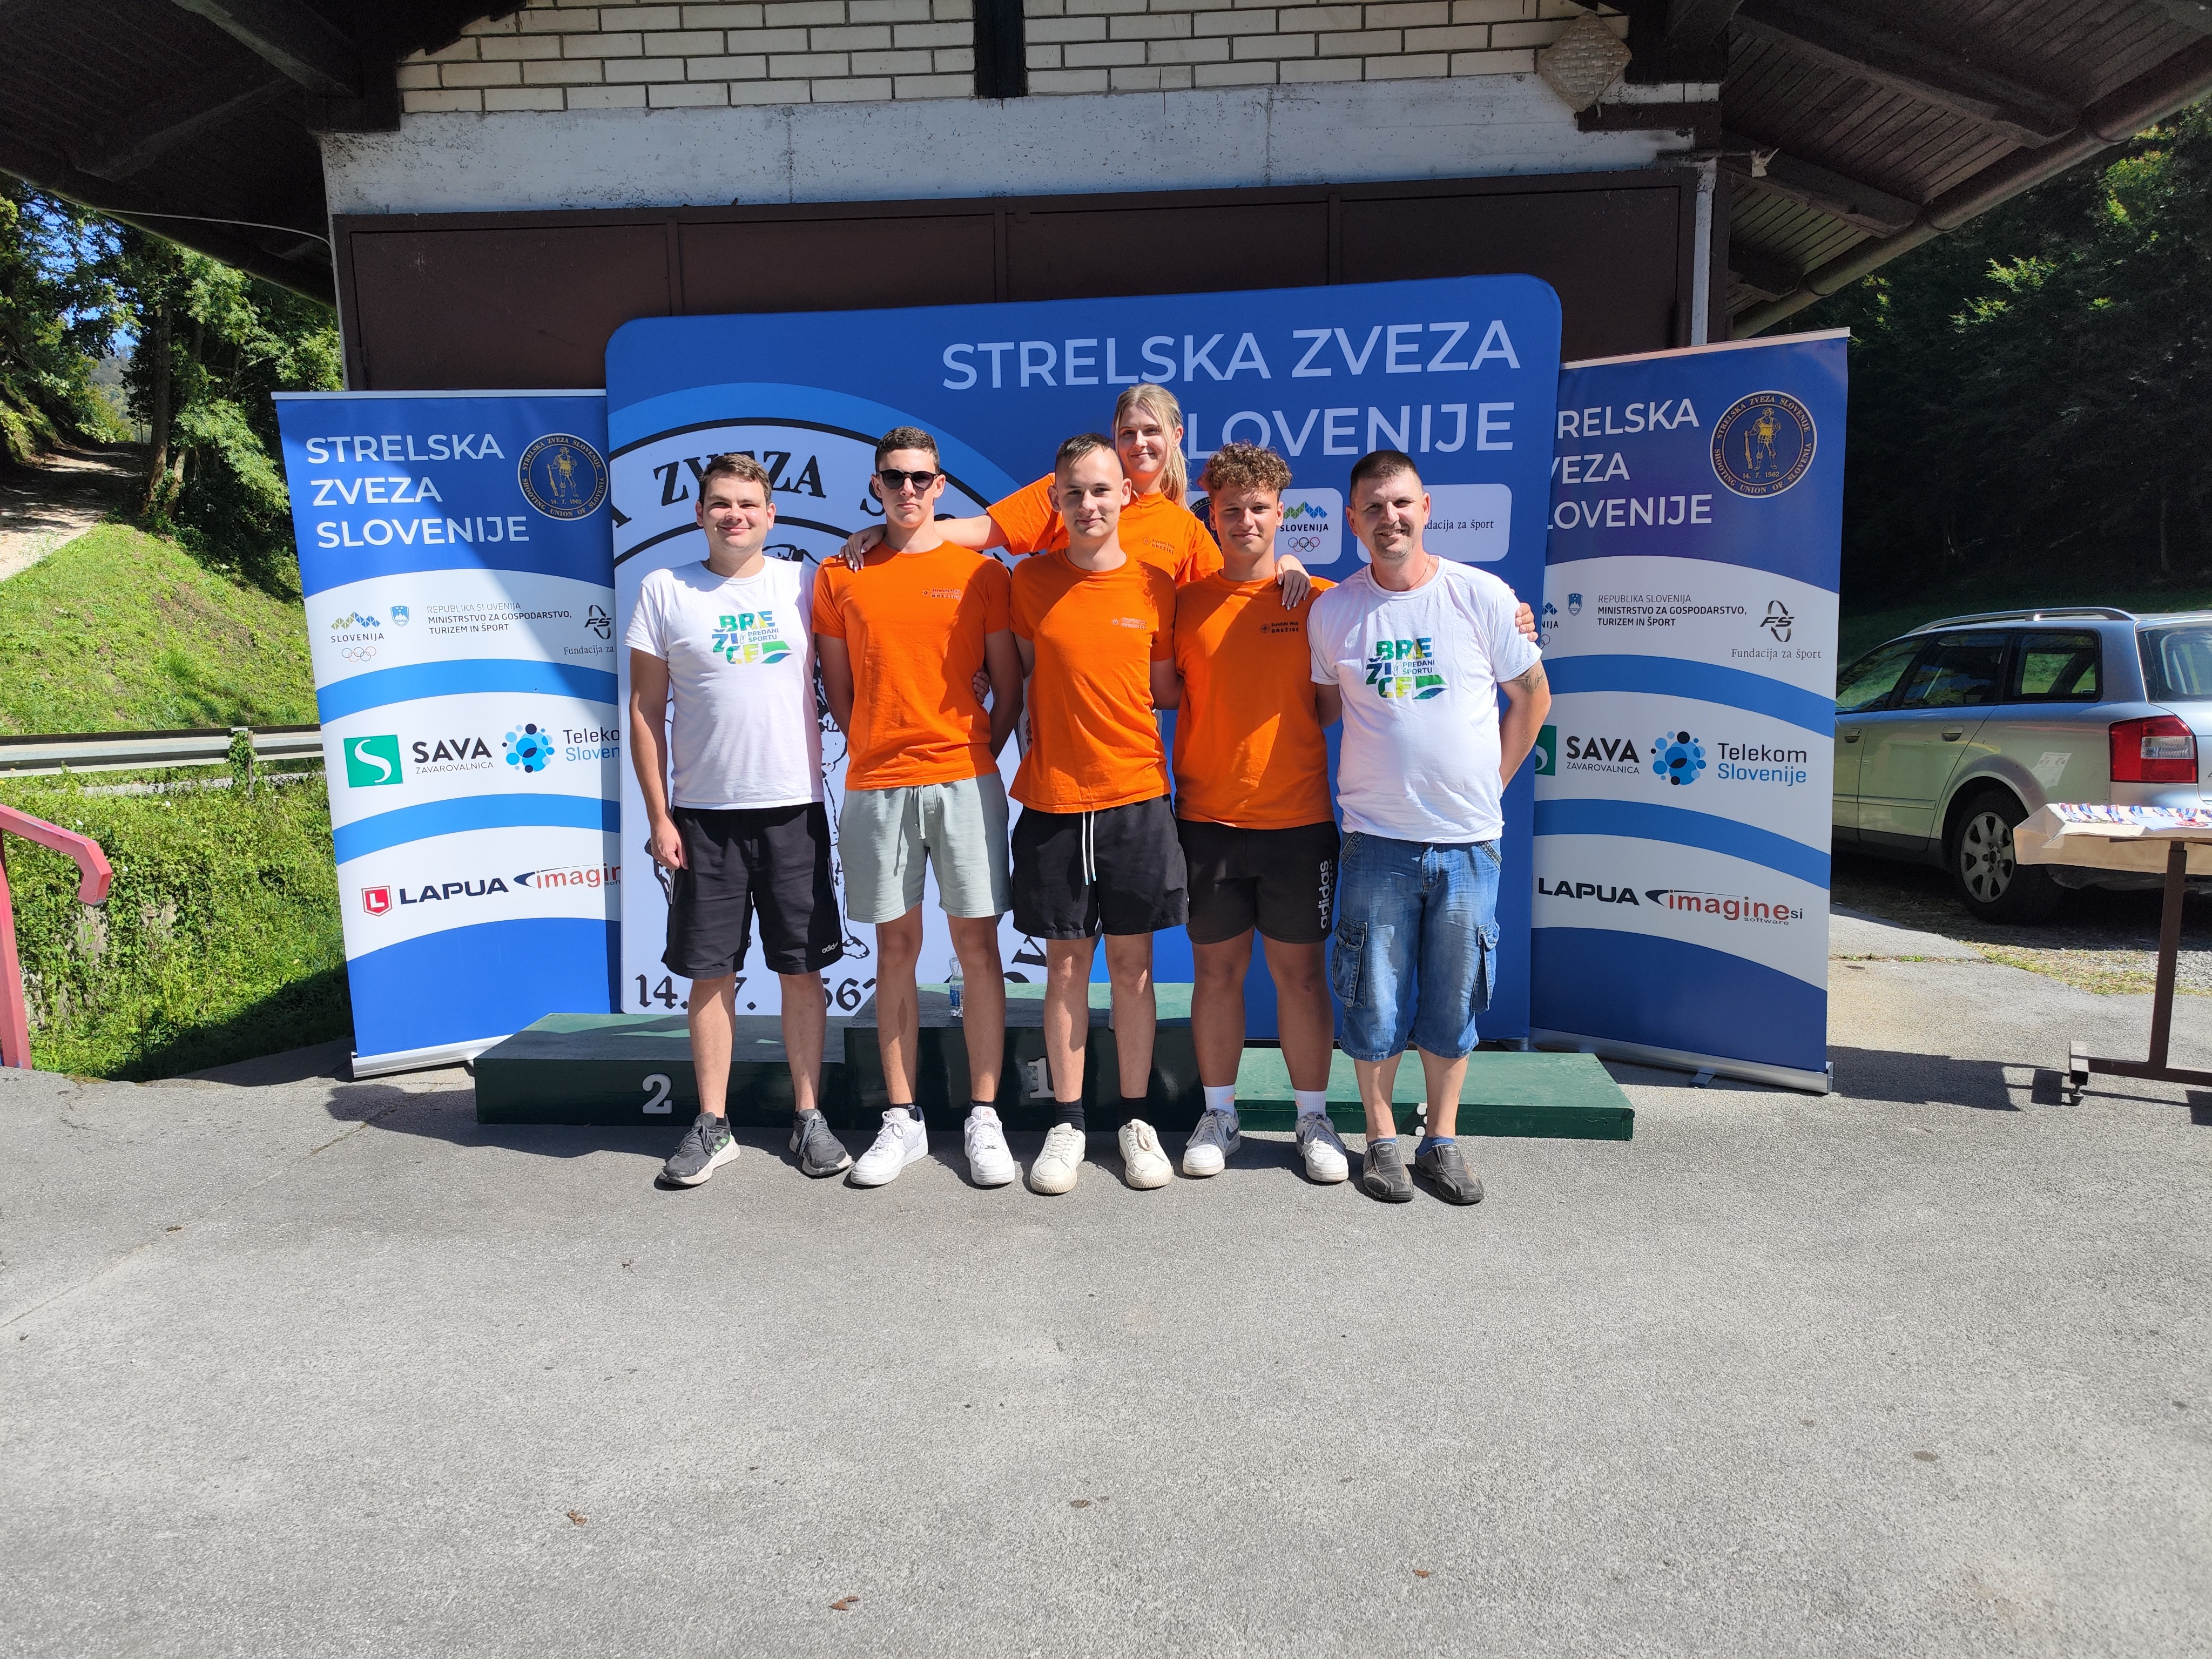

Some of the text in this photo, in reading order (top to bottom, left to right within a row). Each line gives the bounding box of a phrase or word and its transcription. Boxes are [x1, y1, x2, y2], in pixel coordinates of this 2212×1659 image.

[942, 320, 1521, 390] STRELSKA ZVEZA
[1557, 398, 1700, 439] RELSKA
[1717, 396, 1811, 439] STRELSKA ZVEZA SLOVENIJE
[306, 434, 505, 464] STRELSKA
[522, 442, 545, 471] STRELSKA
[572, 440, 602, 469] SLOVENIJE
[653, 450, 826, 506] ZVZA
[1715, 443, 1812, 494] SHOOTING UNION OF SLOVENIA
[311, 477, 443, 506] ZVEZA
[522, 477, 605, 517] SHOOTING UNION OF SLOVENIA
[1547, 494, 1712, 529] OVENIJE
[317, 516, 529, 548] SLOVENIJE
[1280, 523, 1328, 532] SLOVENIJA
[1471, 518, 1494, 530] šport
[427, 602, 521, 613] REPUBLIKA SLOVENIJA
[1598, 595, 1691, 604] REPUBLIKA SLOVENIJA
[428, 613, 487, 624] MINISTRSTVO
[502, 610, 572, 621] GOSPODARSTVO,
[1597, 606, 1654, 615] MINISTRSTVO
[1670, 606, 1747, 616] GOSPODARSTVO,
[1597, 618, 1634, 626] TURIZEM
[1647, 617, 1676, 626] ŠPORT
[331, 632, 384, 643] SLOVENIJA
[430, 623, 509, 635] TURIZEM IN ŠPORT
[748, 628, 779, 637] PREDANI
[748, 634, 777, 643] ŠPORTU
[563, 645, 603, 656] Fundacija
[1731, 648, 1822, 660] Fundacija za šport
[1402, 659, 1434, 667] PREDANI
[1402, 667, 1433, 675] ŠPORTU
[412, 737, 493, 764] SAVA
[1566, 736, 1640, 764] SAVA
[1717, 743, 1807, 764] Telekom
[415, 761, 494, 774] ZAVAROVALNICA
[1566, 761, 1640, 774] ZAVAROVALNICA
[1717, 763, 1807, 787] Slovenije
[399, 878, 509, 905] LAPUA
[1318, 860, 1330, 929] adidas
[1539, 878, 1640, 906] LAPUA
[1744, 916, 1789, 926] software
[1028, 1057, 1055, 1098] 1
[642, 1073, 672, 1114] 2
